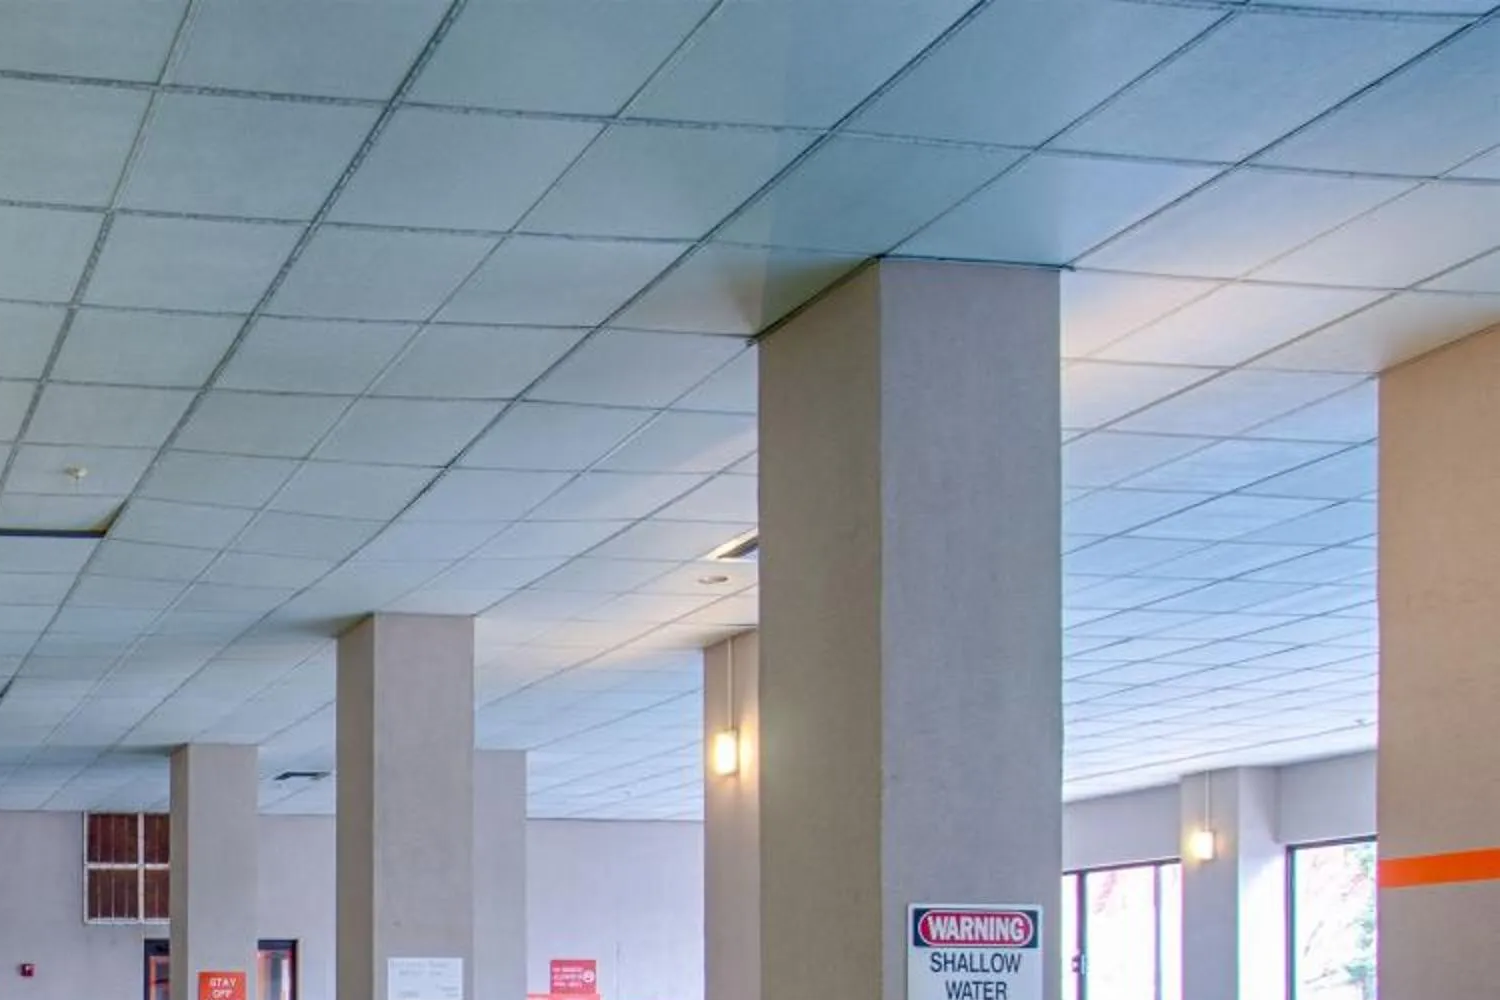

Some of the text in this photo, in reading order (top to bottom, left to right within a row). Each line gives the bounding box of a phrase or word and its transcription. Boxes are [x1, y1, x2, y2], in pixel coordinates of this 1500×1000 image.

[927, 915, 1025, 941] WARNING
[930, 952, 1022, 973] SHALLOW
[209, 977, 237, 987] STAY
[945, 980, 1008, 1000] WATER
[211, 989, 233, 999] OFF
